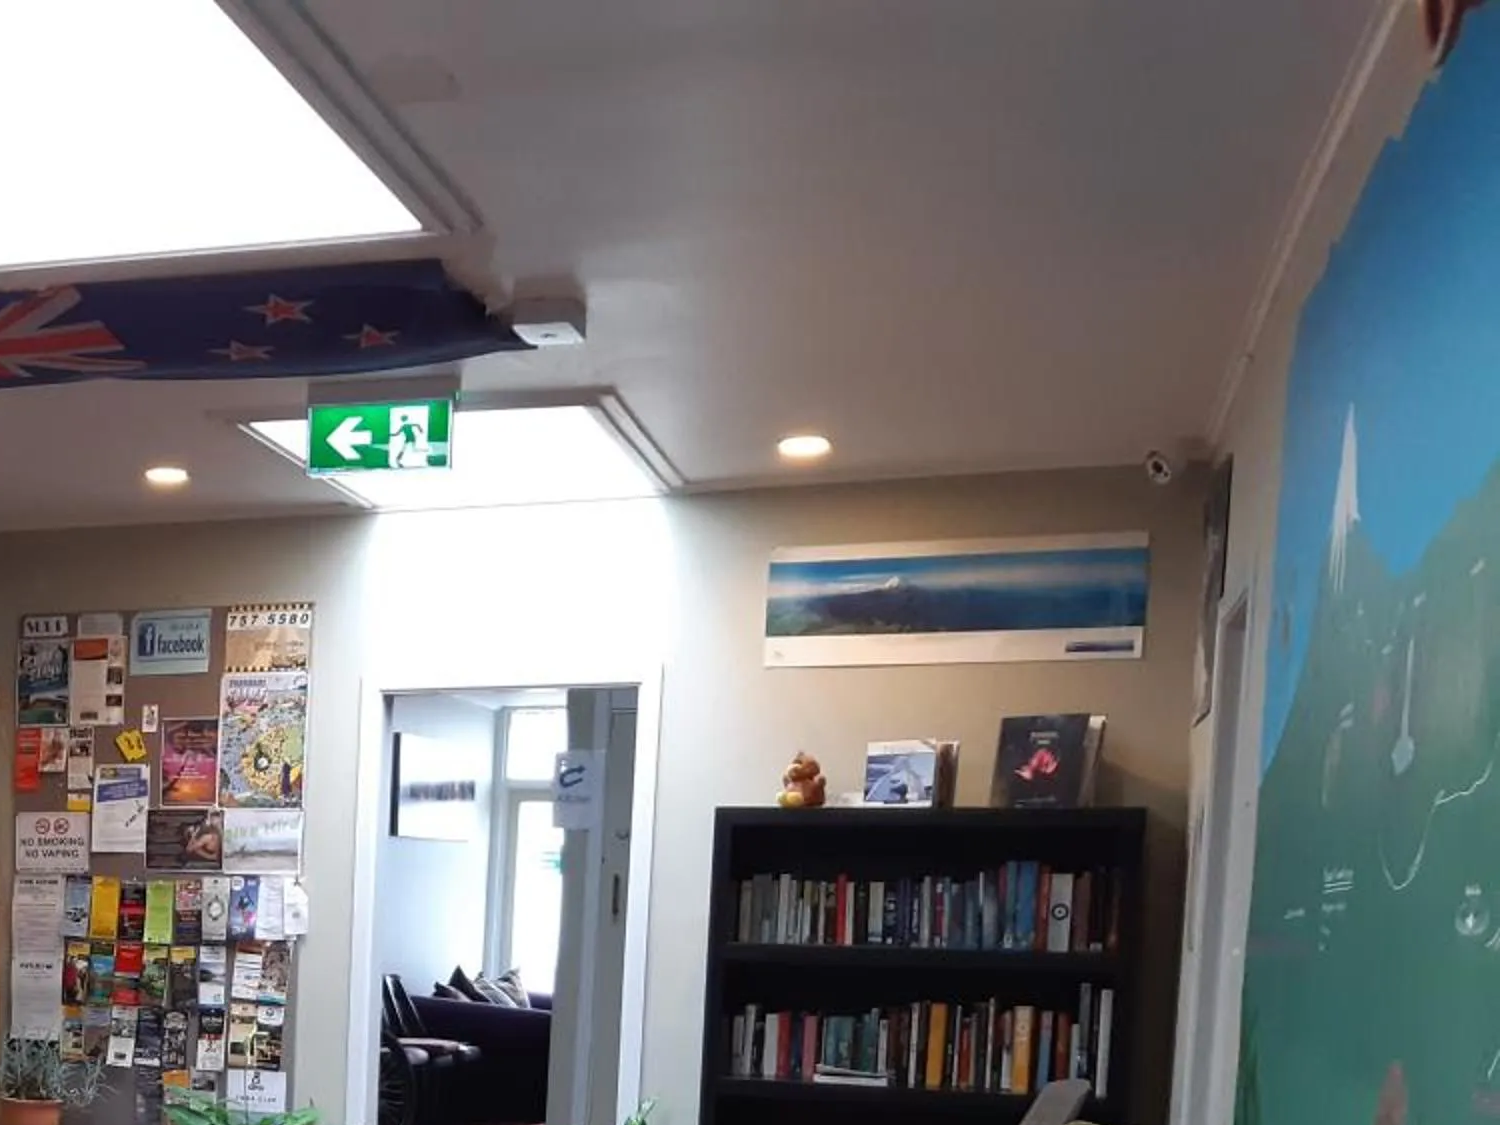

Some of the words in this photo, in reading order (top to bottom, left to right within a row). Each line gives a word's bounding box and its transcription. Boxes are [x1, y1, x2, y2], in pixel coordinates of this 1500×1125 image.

[158, 632, 205, 654] facebook
[20, 838, 34, 846] NO
[38, 837, 85, 846] SMOKING
[25, 850, 38, 858] NO
[41, 849, 79, 858] VAPING
